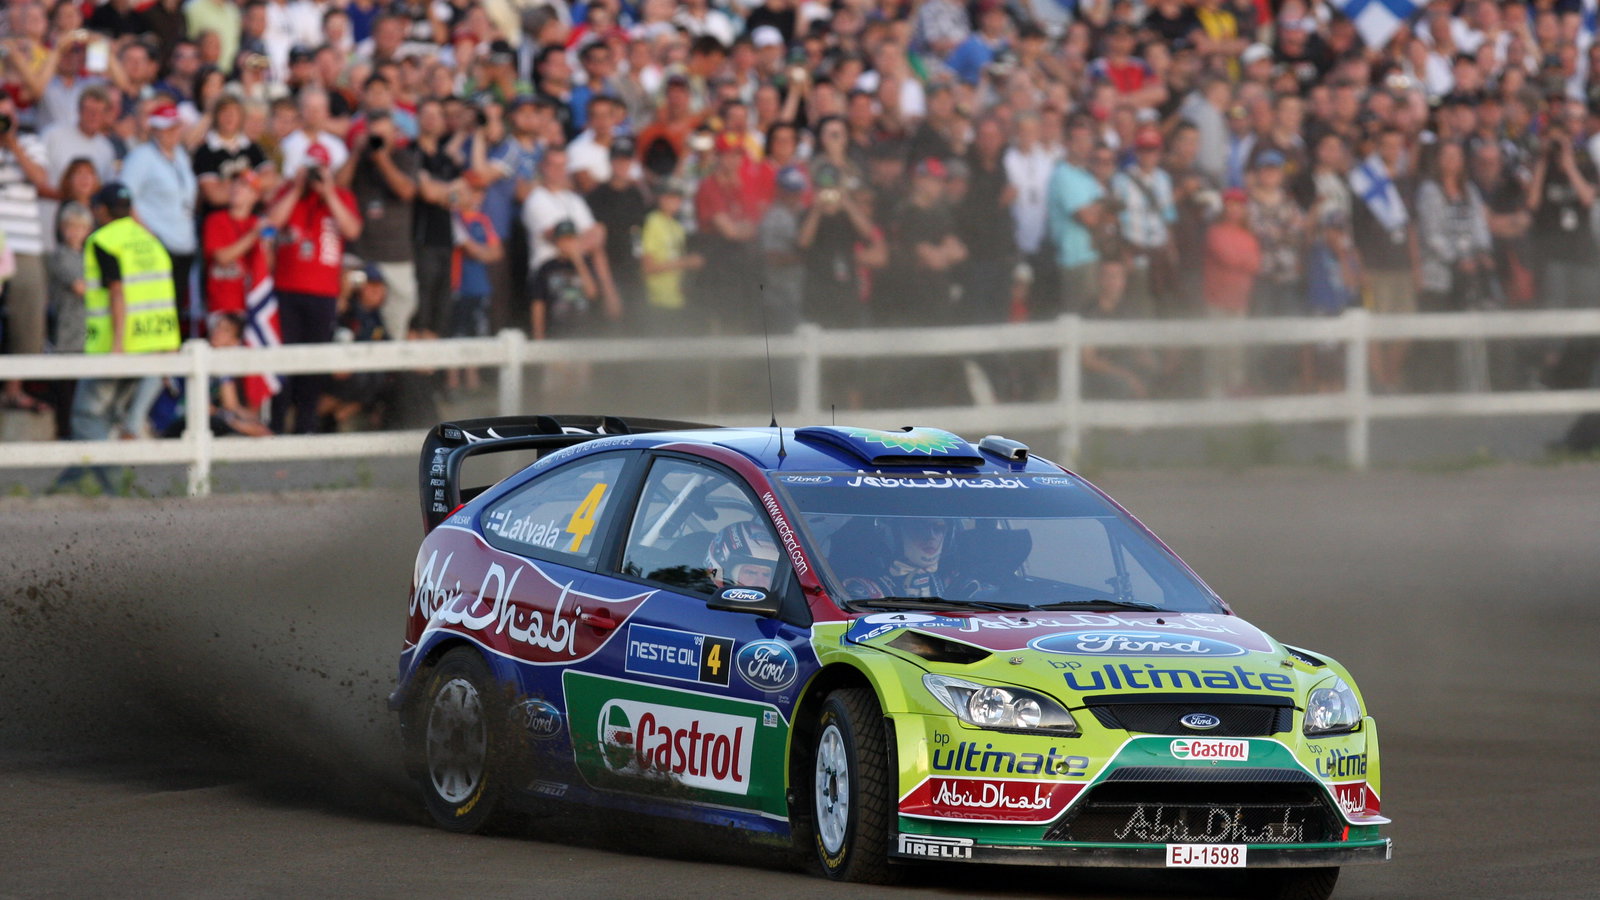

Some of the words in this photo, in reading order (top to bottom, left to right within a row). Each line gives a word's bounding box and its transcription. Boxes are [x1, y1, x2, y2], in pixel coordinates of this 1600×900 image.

[786, 475, 824, 484] Ford
[847, 469, 923, 488] Abu
[922, 470, 1030, 489] Dhabi
[500, 509, 560, 549] Latvala
[565, 482, 608, 552] 4
[762, 491, 808, 576] www.wrcford.com
[409, 549, 468, 624] Abu
[463, 561, 581, 656] Dhabi
[729, 590, 758, 600] Ford
[855, 622, 917, 643] NESTE
[959, 615, 1068, 633] Abu
[629, 640, 676, 664] NESTE
[678, 648, 698, 667] OIL
[1076, 633, 1211, 653] Ford
[706, 644, 722, 676] 4
[748, 646, 788, 683] Ford
[1047, 659, 1082, 671] bp
[1063, 663, 1295, 693] ultimate
[523, 704, 554, 733] Ford
[1190, 715, 1212, 725] Ford
[636, 712, 743, 783] Castrol
[934, 730, 950, 747] bp
[1190, 741, 1245, 758] Castrol
[1306, 742, 1322, 755] bp
[932, 741, 1090, 777] ultimate
[932, 780, 981, 807] Abu
[980, 782, 1053, 810] Dhabi
[1114, 805, 1195, 842] Abu
[1202, 806, 1306, 842] Dhabi
[898, 832, 975, 860] PIRELLI
[1172, 846, 1240, 865] EJ-1598
